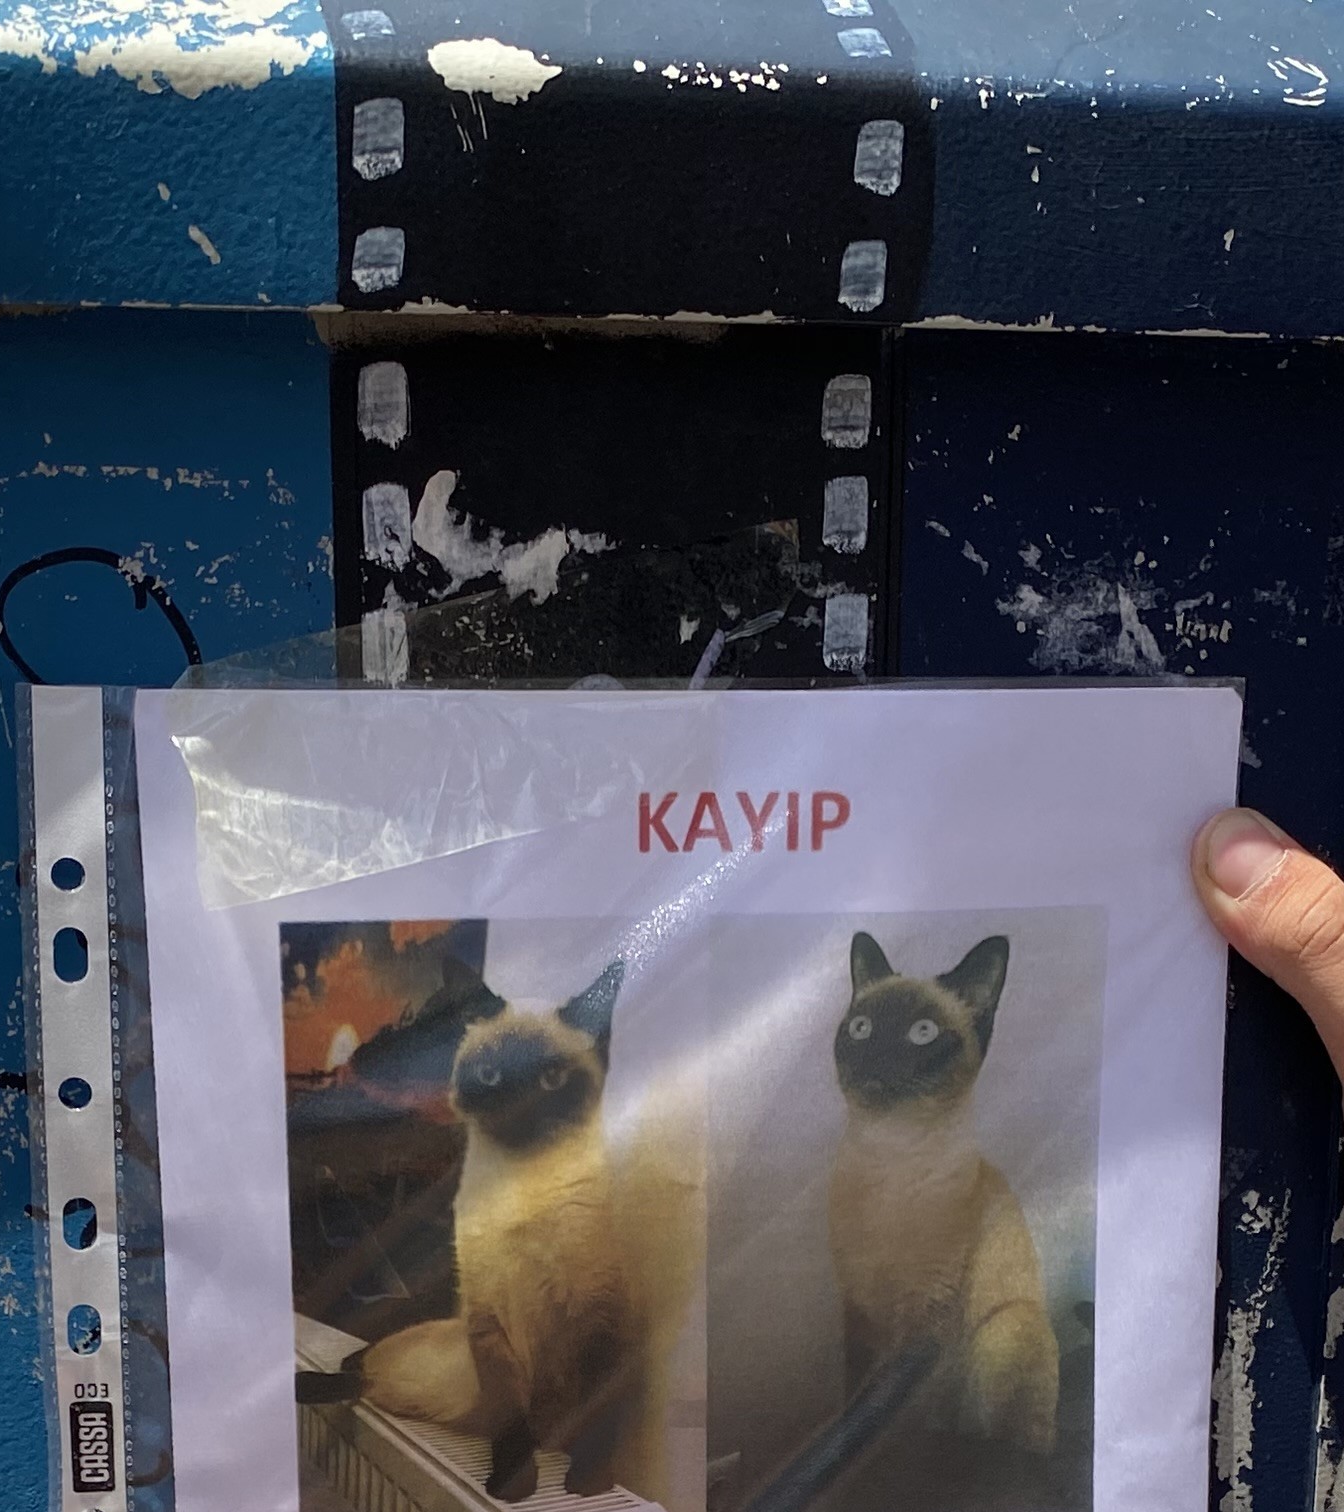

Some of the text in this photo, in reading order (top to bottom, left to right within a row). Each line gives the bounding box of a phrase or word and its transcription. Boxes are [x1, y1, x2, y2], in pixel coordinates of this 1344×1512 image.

[637, 790, 852, 853] KAYIP
[74, 1382, 110, 1399] ECO
[78, 1412, 110, 1483] CASSA
